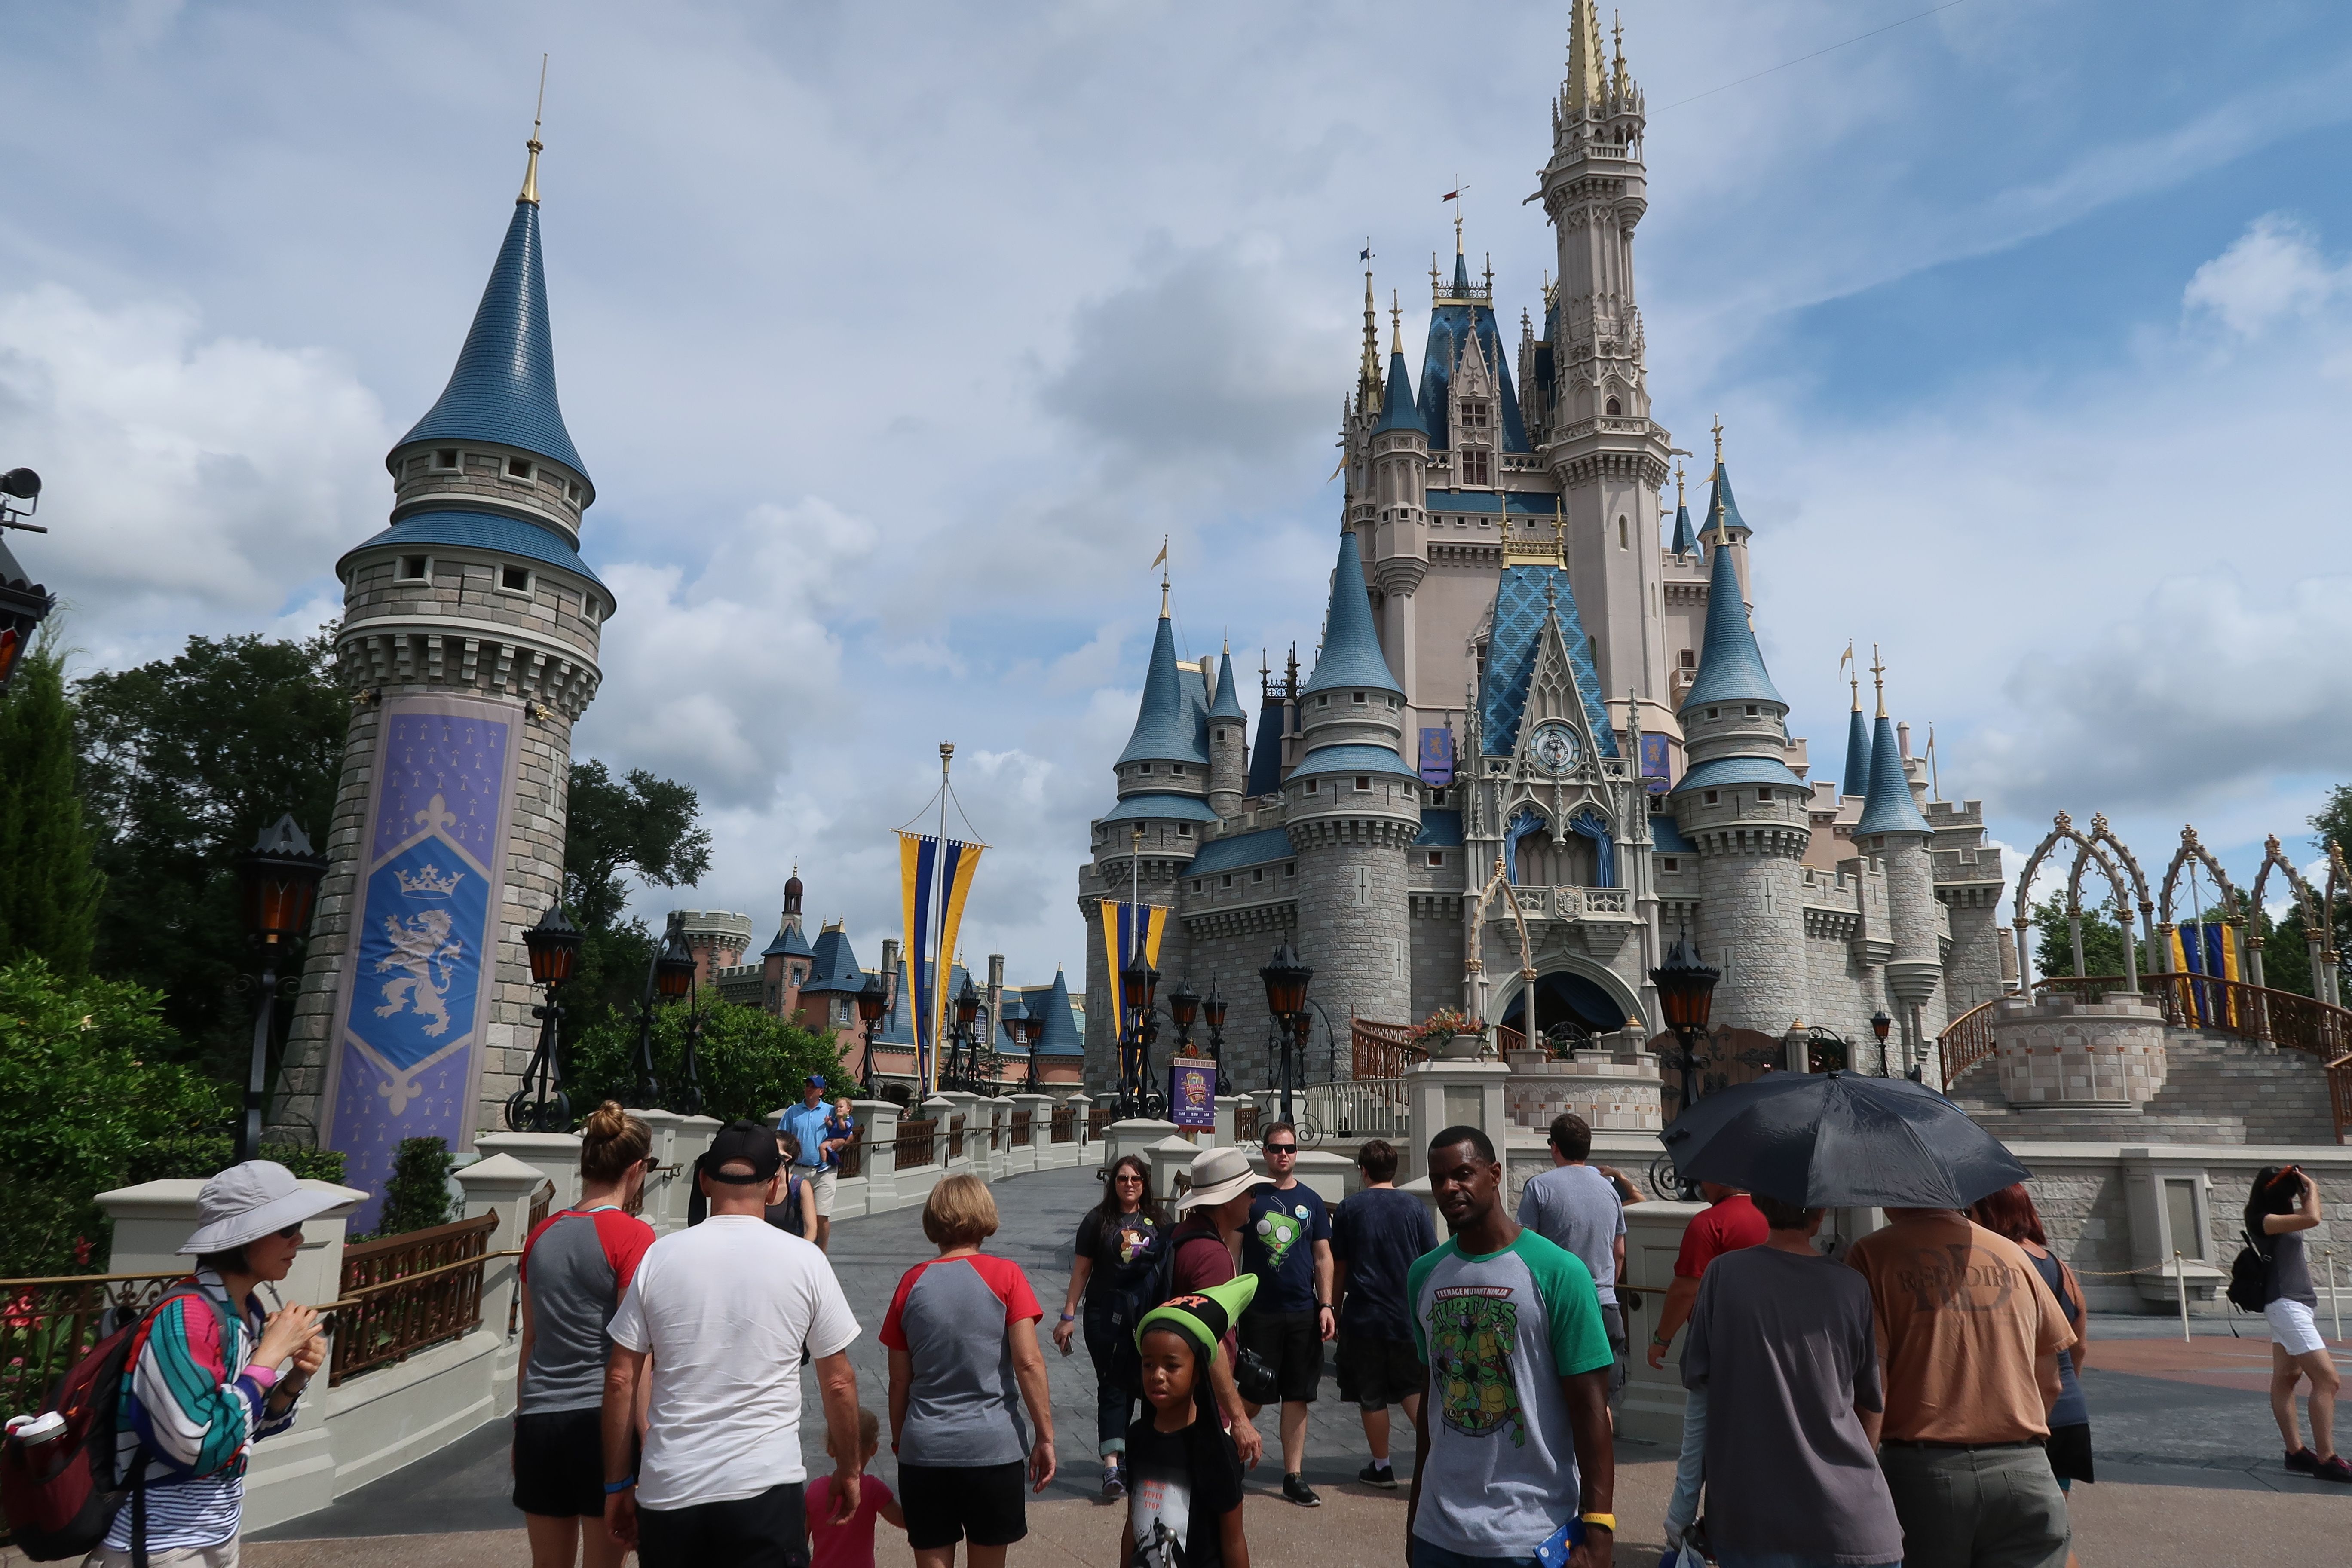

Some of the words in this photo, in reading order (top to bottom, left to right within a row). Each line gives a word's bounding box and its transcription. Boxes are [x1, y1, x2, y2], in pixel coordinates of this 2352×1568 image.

[1436, 1289, 1463, 1298] TEENAGE
[1157, 1295, 1209, 1309] OFY
[1426, 1295, 1517, 1328] TURTLES
[1143, 1491, 1163, 1501] NEVER
[1144, 1501, 1159, 1510] STOP
